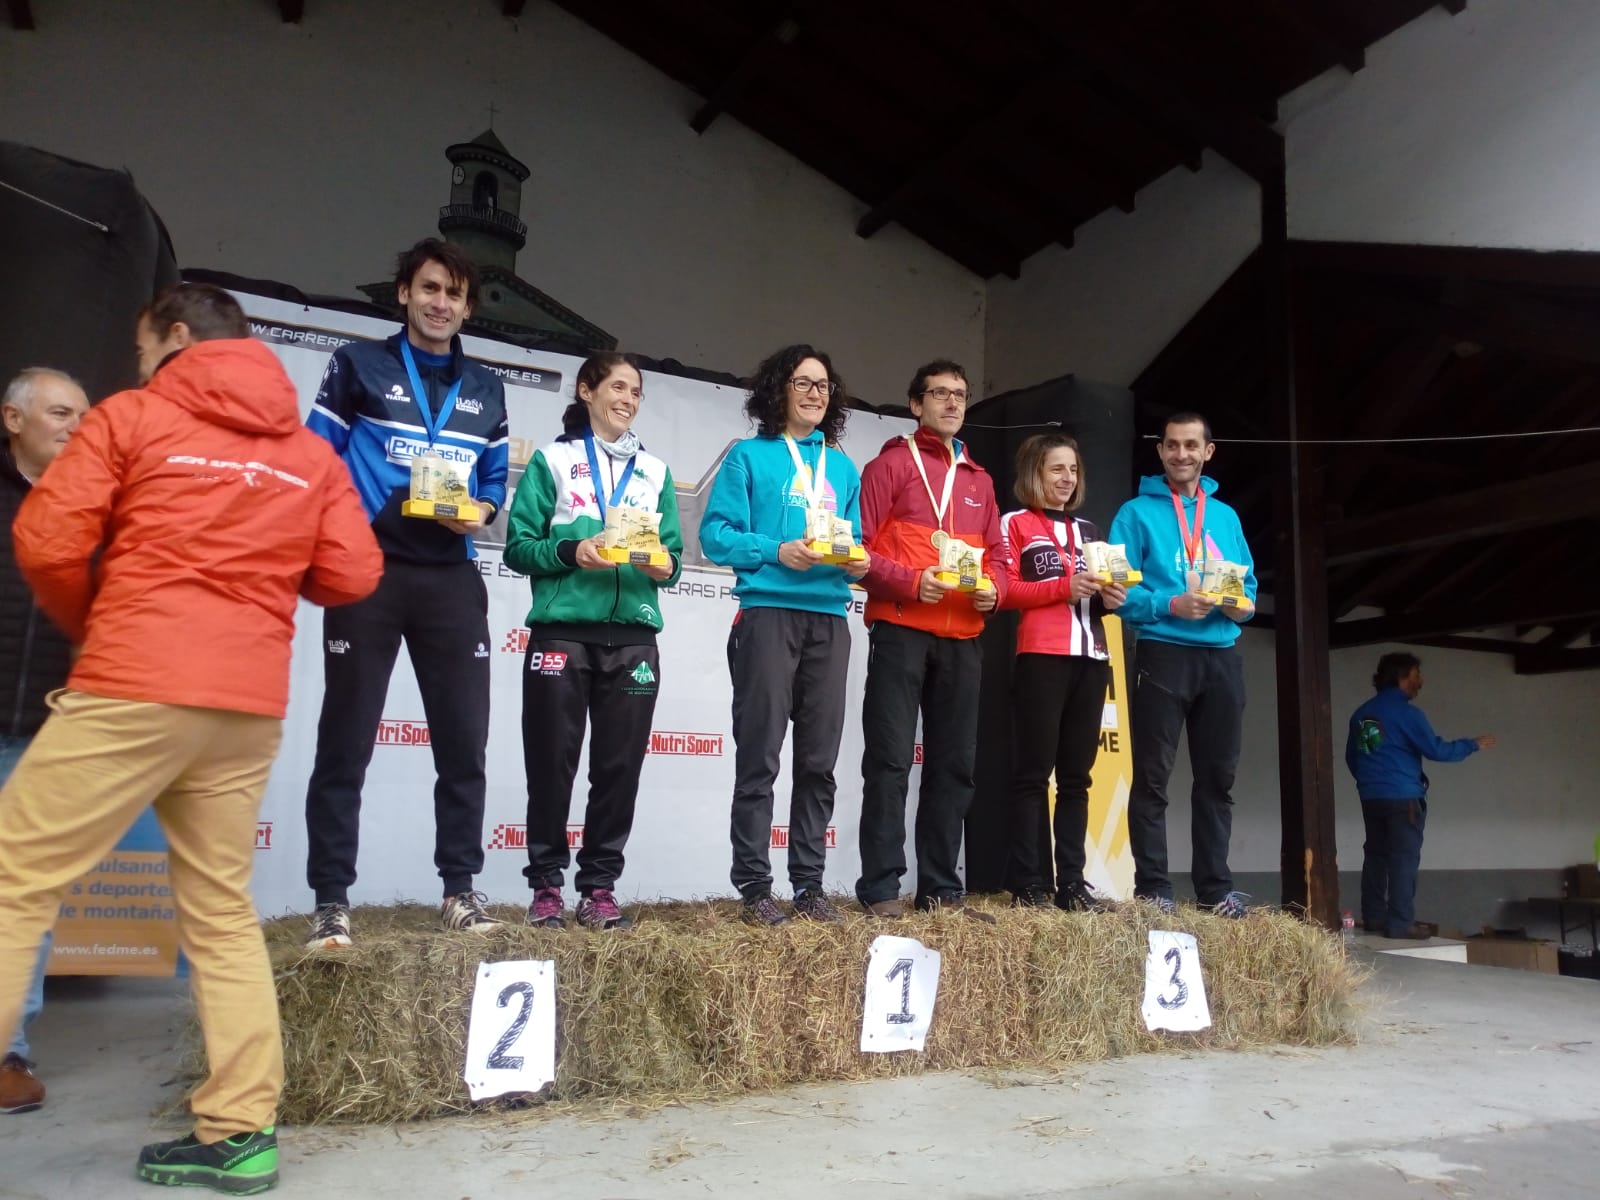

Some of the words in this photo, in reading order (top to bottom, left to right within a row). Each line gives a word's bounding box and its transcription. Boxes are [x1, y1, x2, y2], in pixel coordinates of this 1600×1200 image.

[651, 733, 724, 756] NutriSport
[84, 903, 175, 920] montaña
[53, 943, 159, 956] www.fedme.es
[885, 958, 915, 1025] 1
[1156, 946, 1189, 1010] 3
[486, 981, 535, 1072] 2
